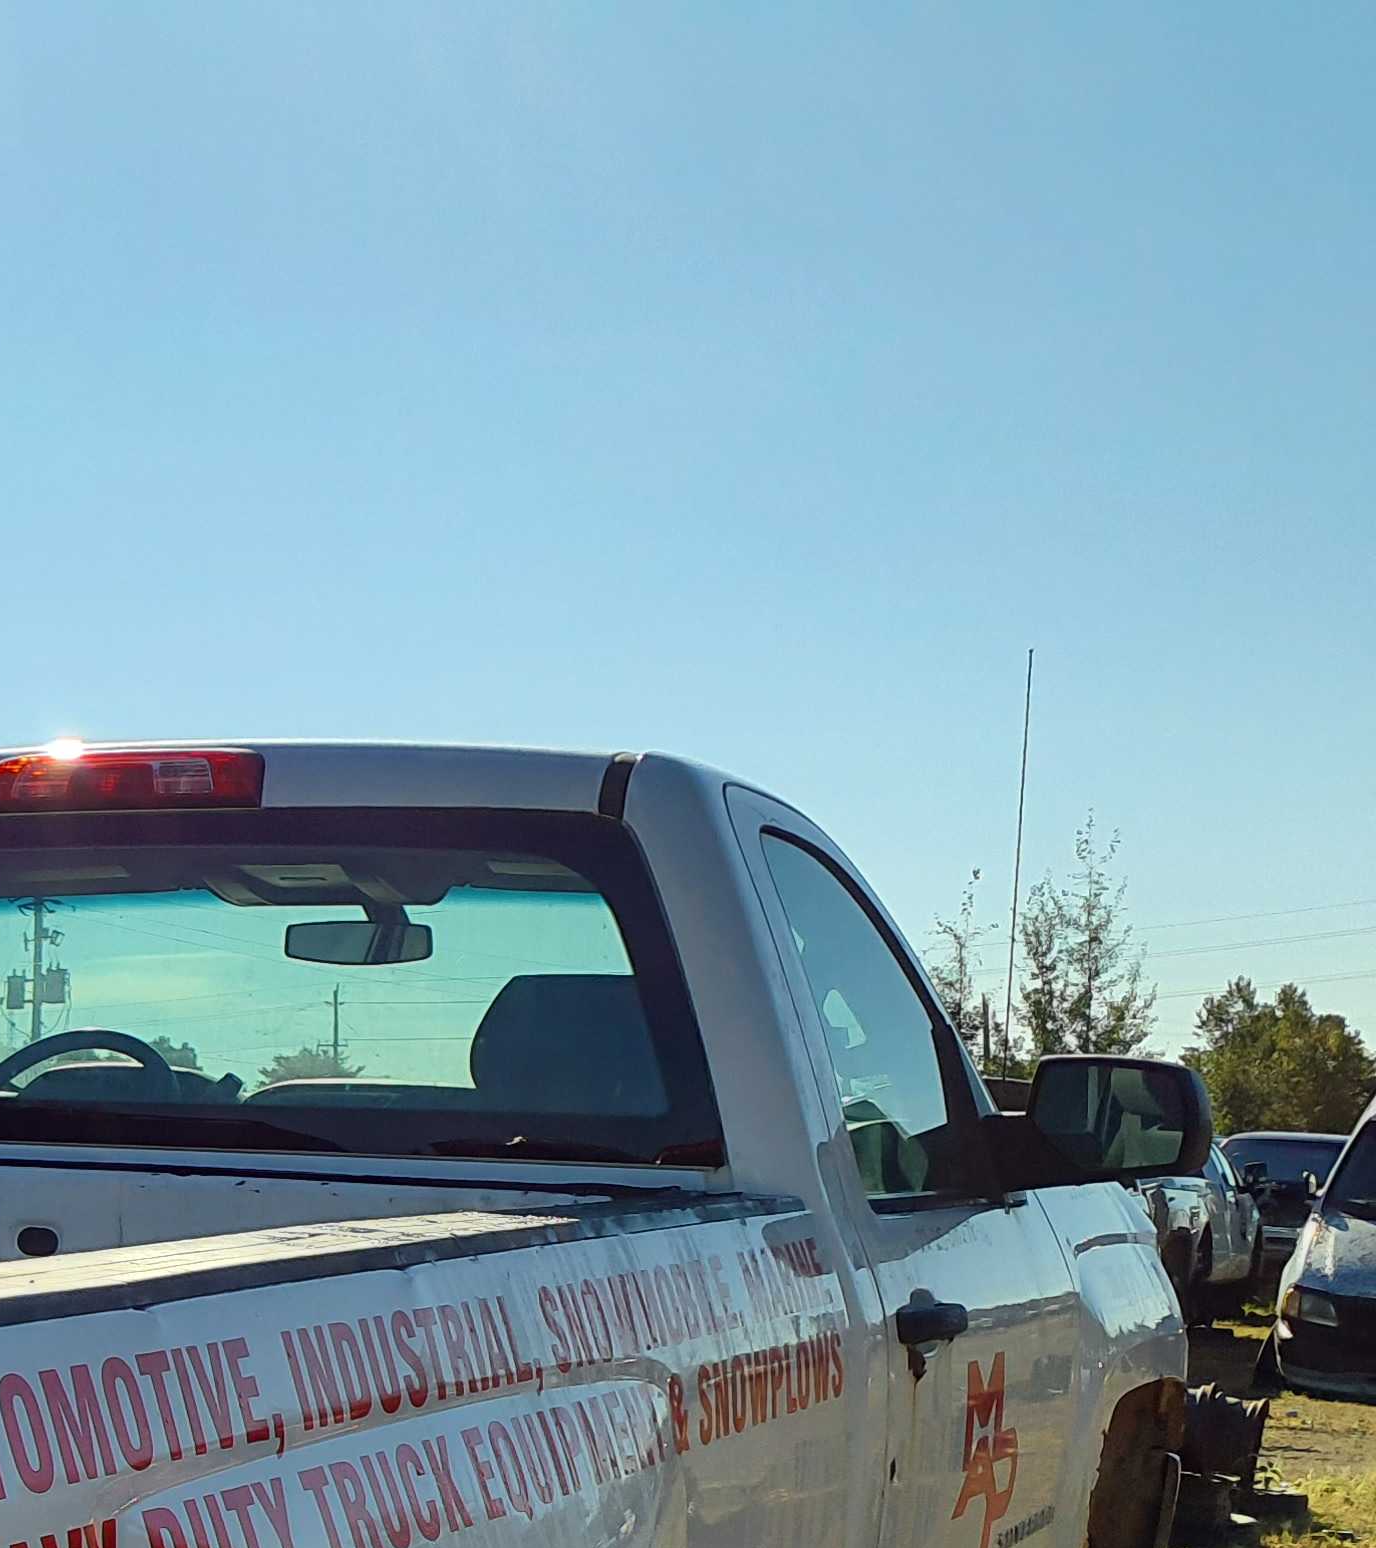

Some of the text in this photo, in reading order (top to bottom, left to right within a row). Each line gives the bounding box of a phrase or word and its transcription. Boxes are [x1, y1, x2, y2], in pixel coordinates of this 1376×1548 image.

[279, 1293, 545, 1432] INDUSTRIAL,
[461, 1384, 668, 1521] EQUIPMENT
[668, 1371, 690, 1456] &
[698, 1330, 844, 1447] SNOWPLOWS
